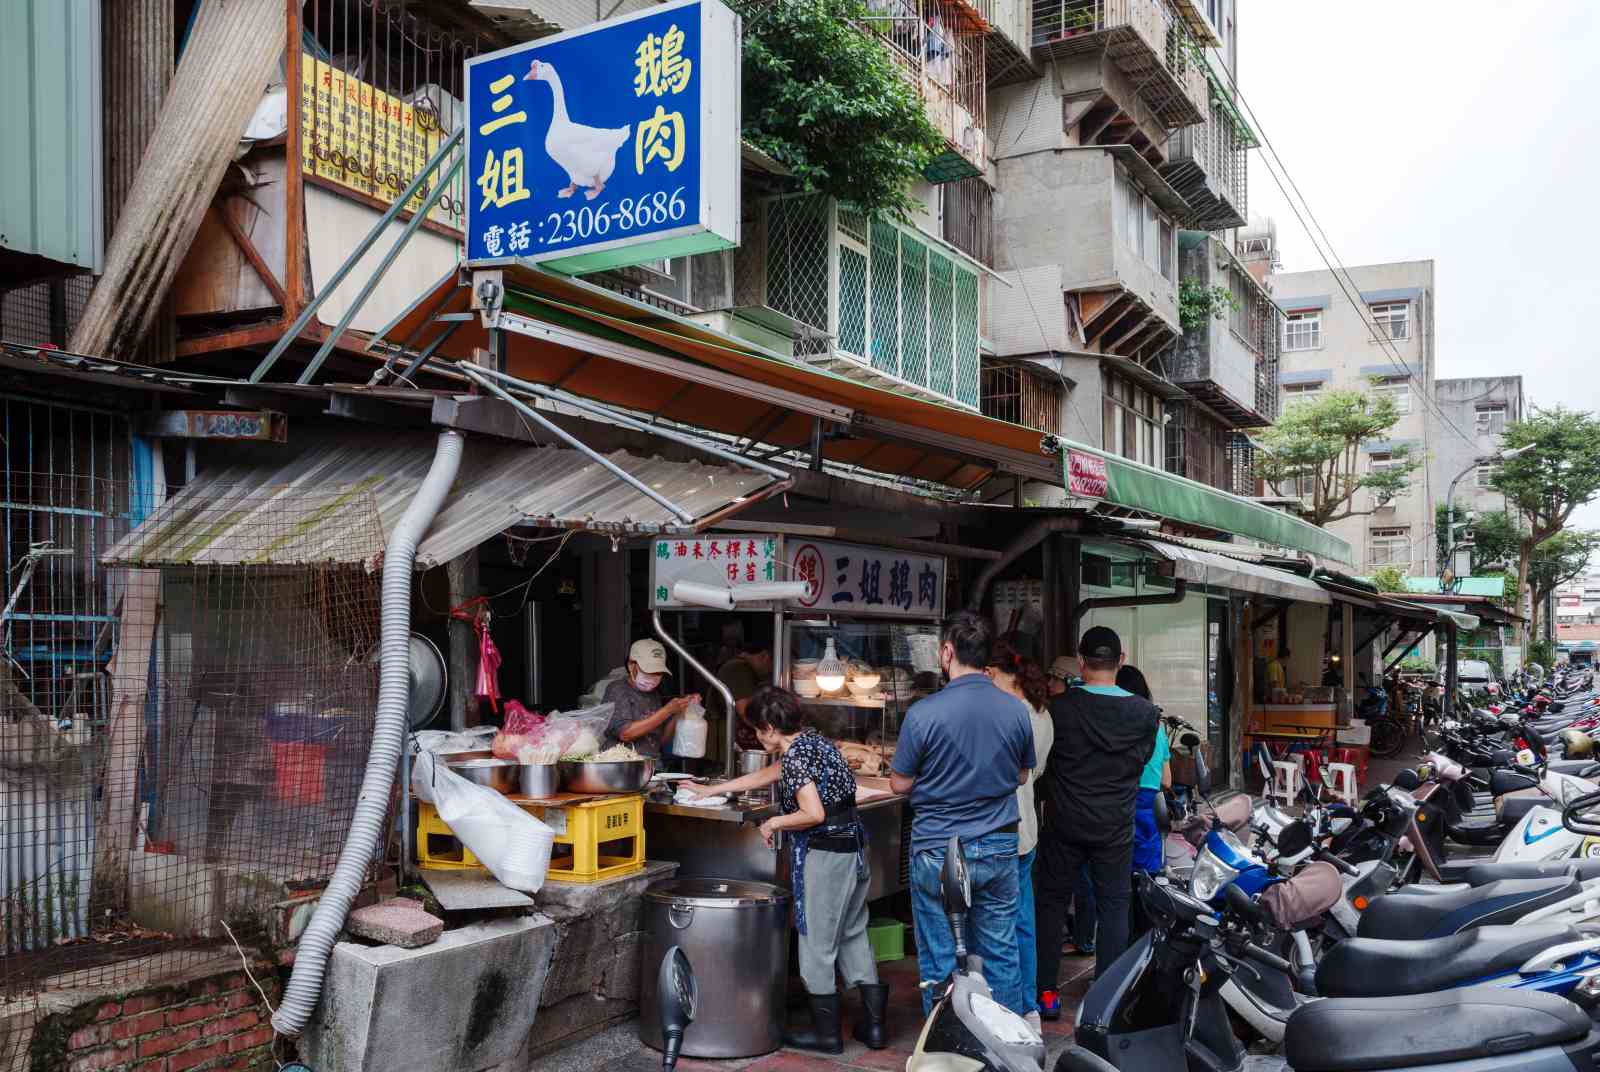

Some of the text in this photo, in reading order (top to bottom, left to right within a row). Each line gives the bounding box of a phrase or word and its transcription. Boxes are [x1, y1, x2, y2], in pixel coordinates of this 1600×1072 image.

[476, 74, 531, 213] 三姐
[634, 24, 692, 176] 鵝肉
[831, 556, 937, 611] 三姐鵝肉
